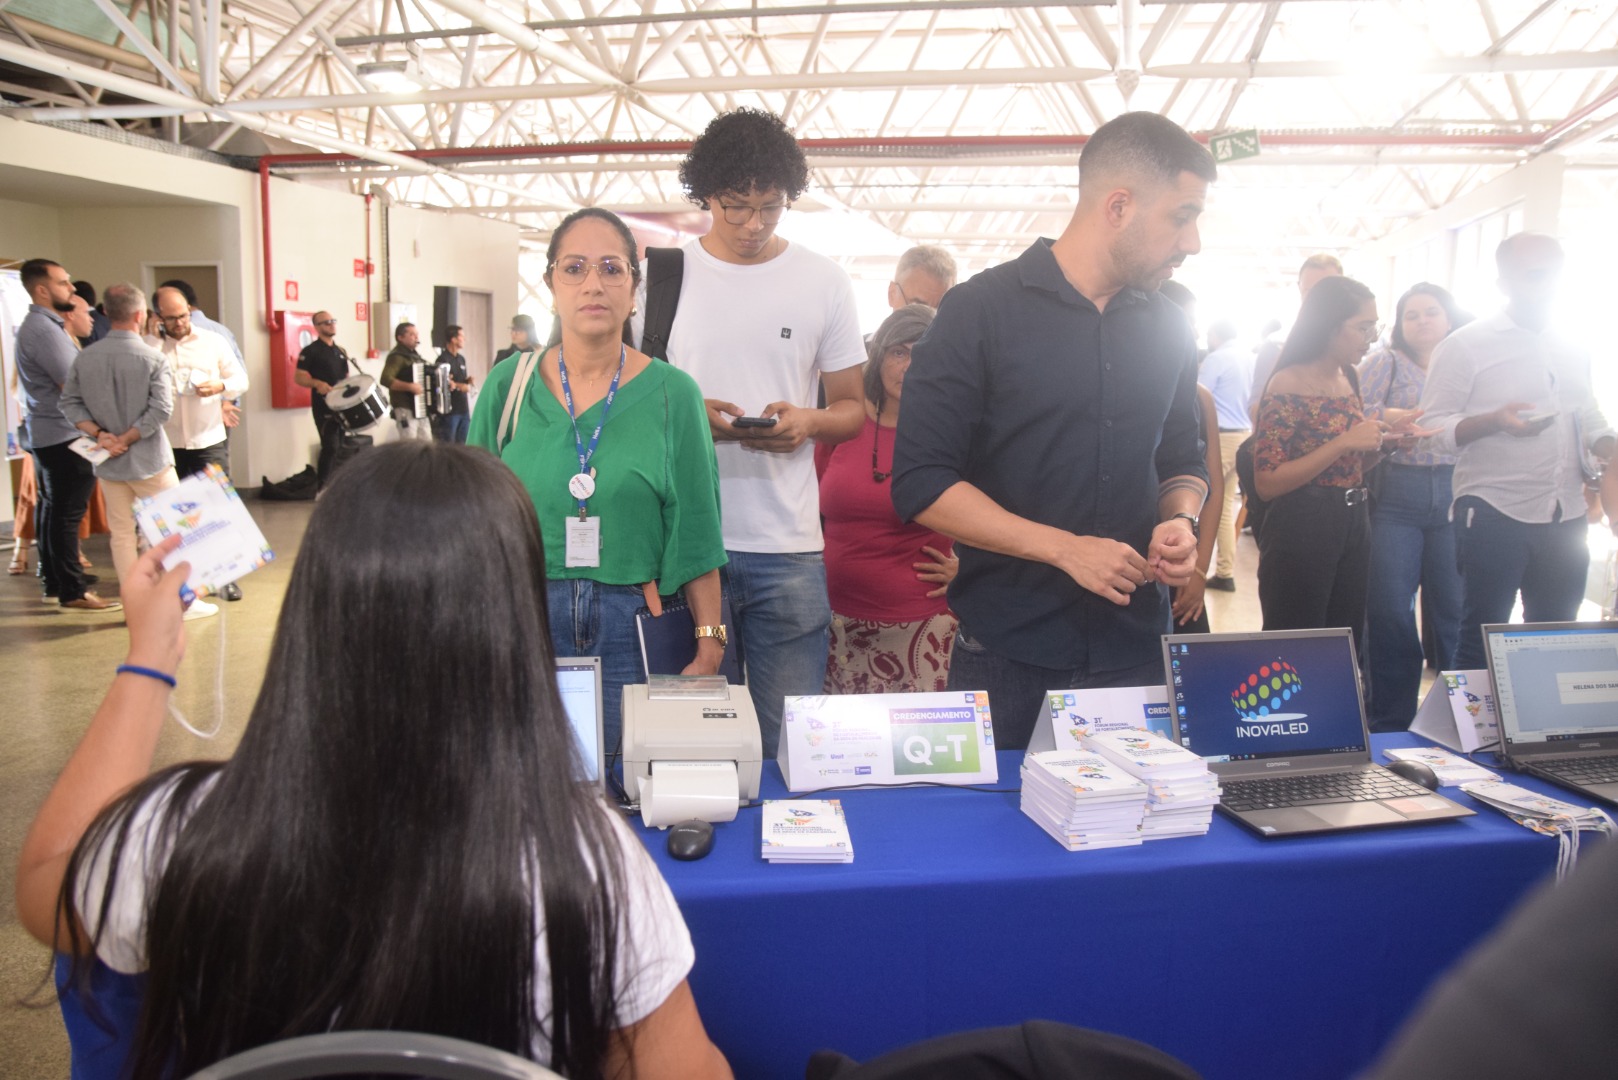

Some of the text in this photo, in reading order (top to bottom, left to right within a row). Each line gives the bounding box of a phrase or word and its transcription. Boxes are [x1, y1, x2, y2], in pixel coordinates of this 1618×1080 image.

[893, 711, 971, 720] CREDENCIAMENTO
[1236, 722, 1309, 738] INOVALED
[903, 734, 967, 766] Q-T
